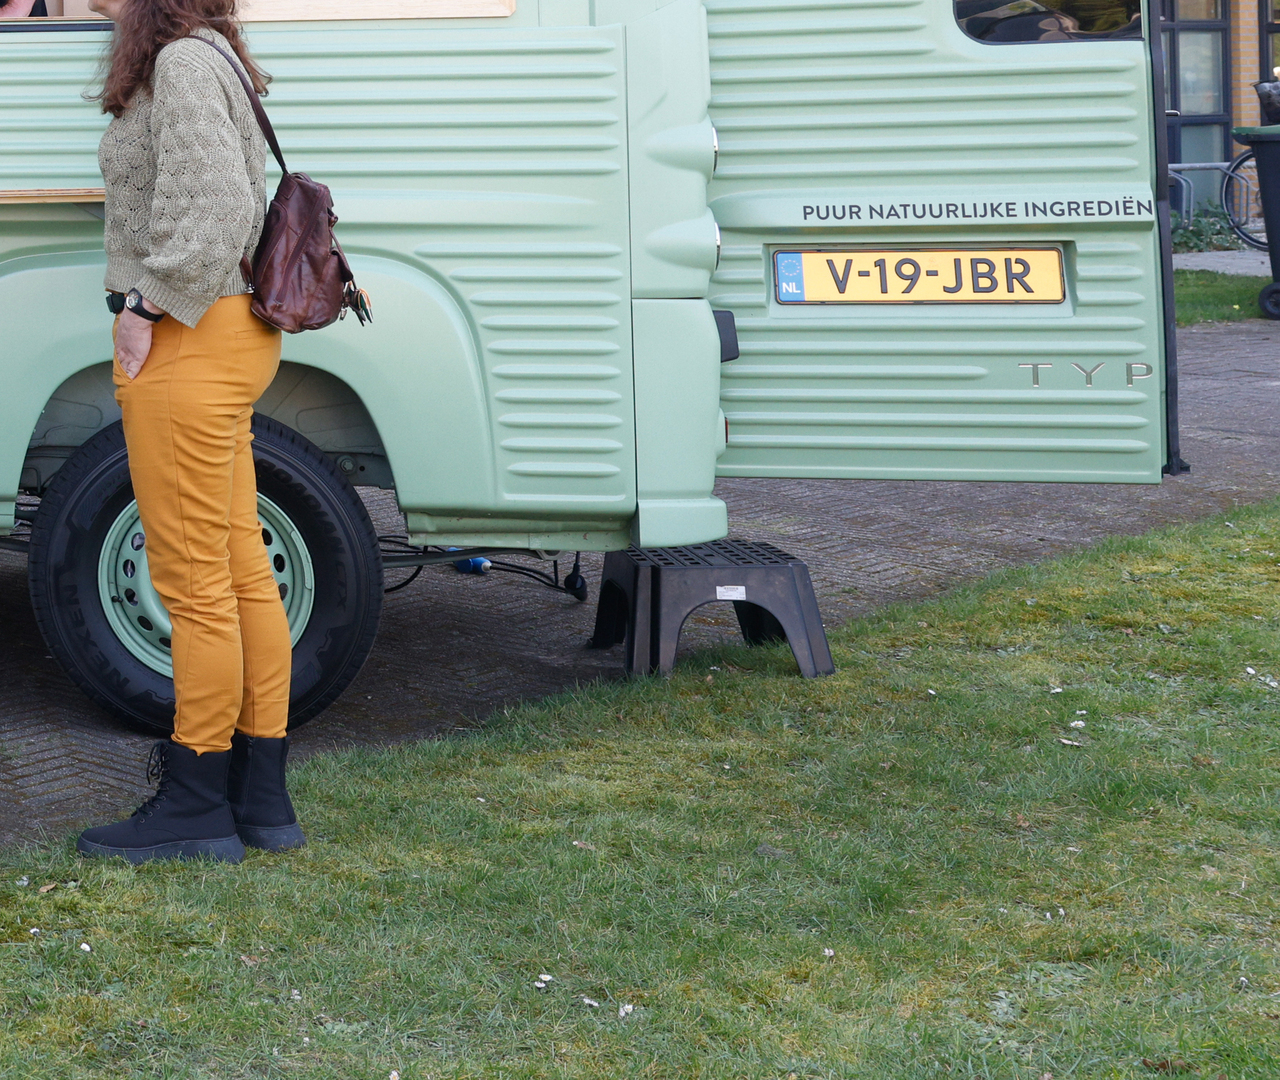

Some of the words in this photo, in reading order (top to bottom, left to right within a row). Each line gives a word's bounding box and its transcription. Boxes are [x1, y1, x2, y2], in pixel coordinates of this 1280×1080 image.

[802, 204, 861, 221] PUUR
[869, 202, 1017, 220] NATUURLIJKE
[1024, 196, 1153, 218] INGREDIËN
[782, 282, 801, 294] NL
[826, 257, 1035, 294] V-19-JBR
[1018, 362, 1153, 387] TYP
